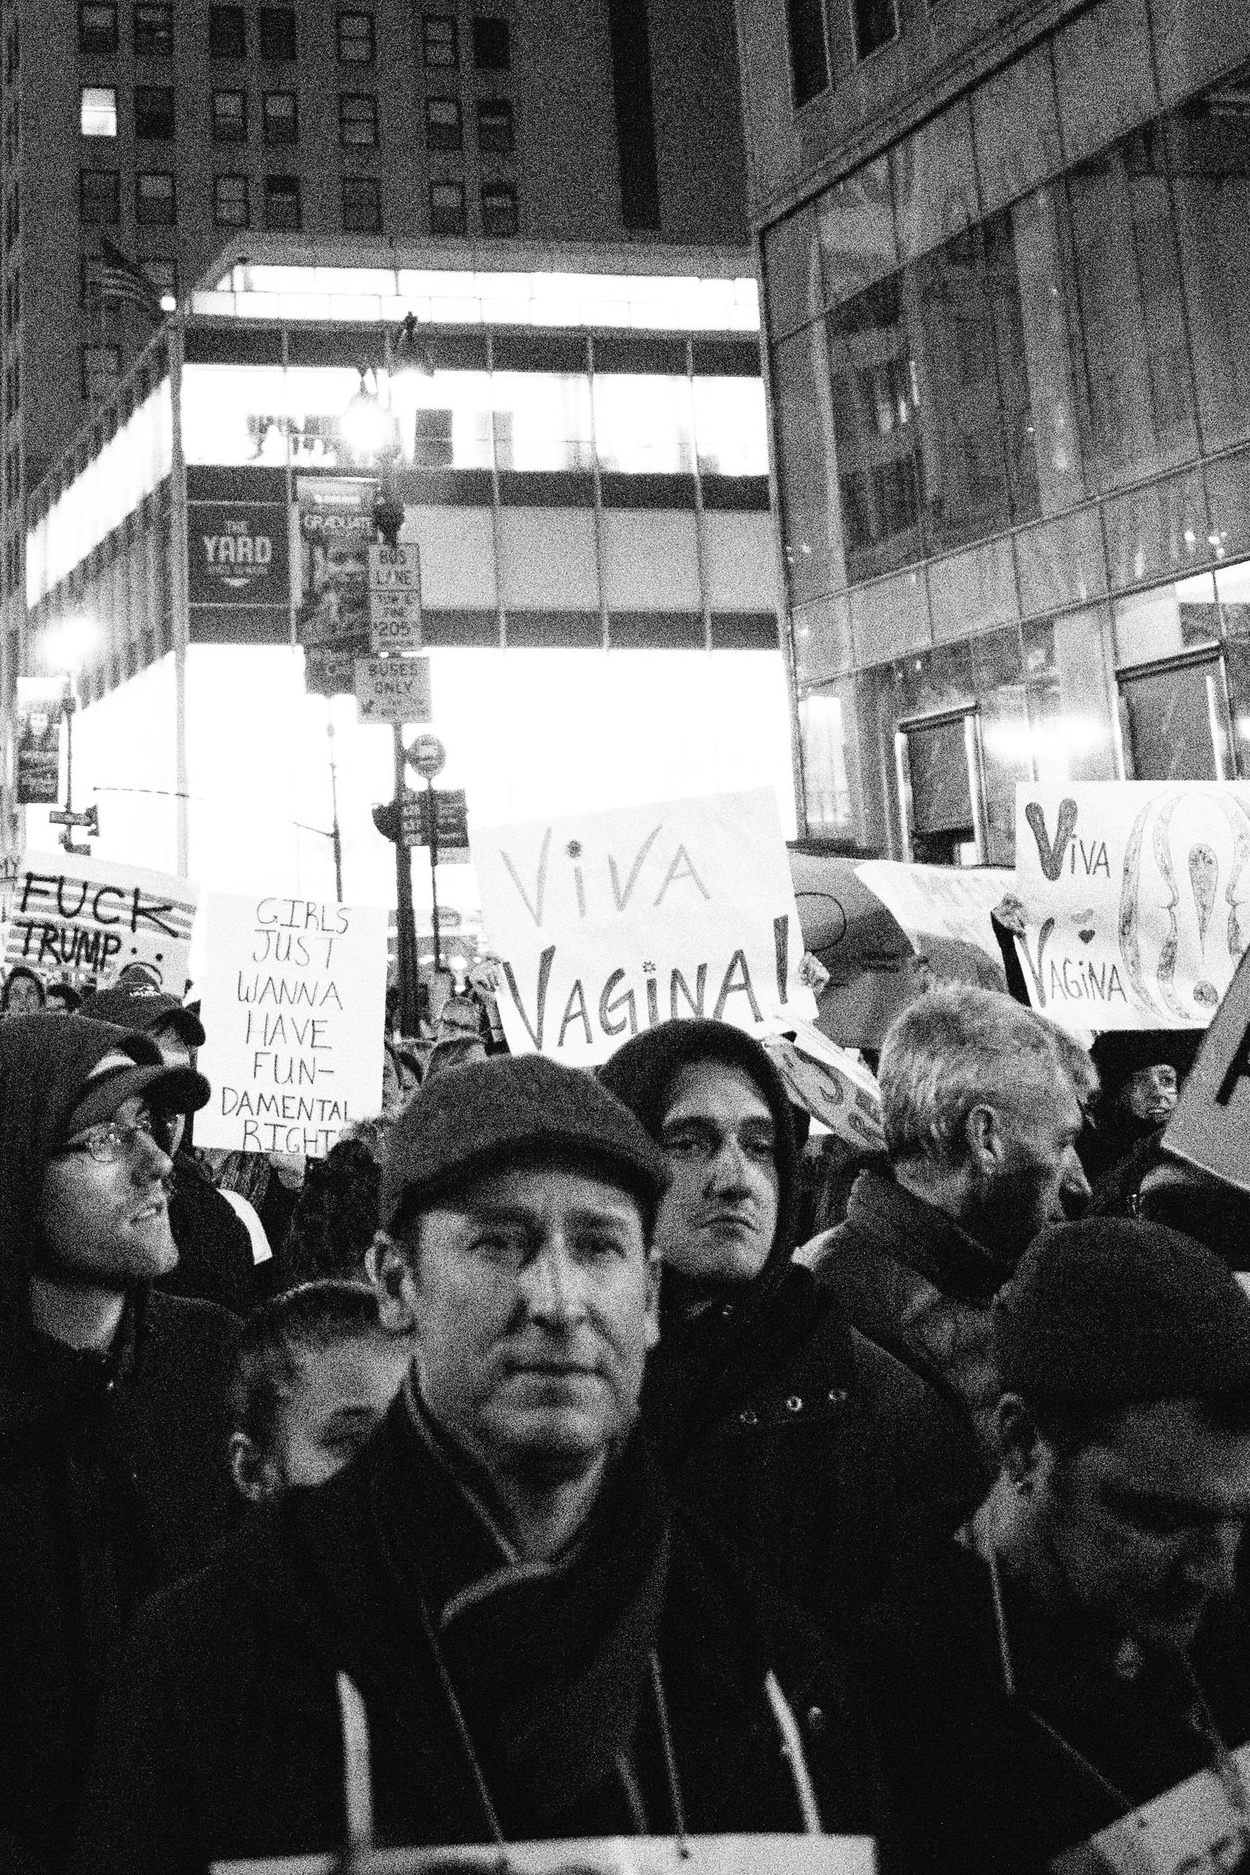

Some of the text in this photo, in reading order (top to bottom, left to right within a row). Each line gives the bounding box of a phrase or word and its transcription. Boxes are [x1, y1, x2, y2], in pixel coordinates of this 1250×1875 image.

[203, 535, 272, 563] YARD
[379, 549, 407, 565] BUS
[368, 663, 419, 677] BUSES
[375, 680, 414, 694] ONLY
[19, 871, 180, 939] FUCK
[256, 897, 352, 935] GIRLS
[14, 920, 122, 972] TRUMP
[252, 928, 343, 969] JUST
[237, 970, 344, 1011] WANNA
[246, 1010, 333, 1049] HAVE
[253, 1051, 335, 1085] FUN-
[222, 1086, 350, 1123] DAMENTAL
